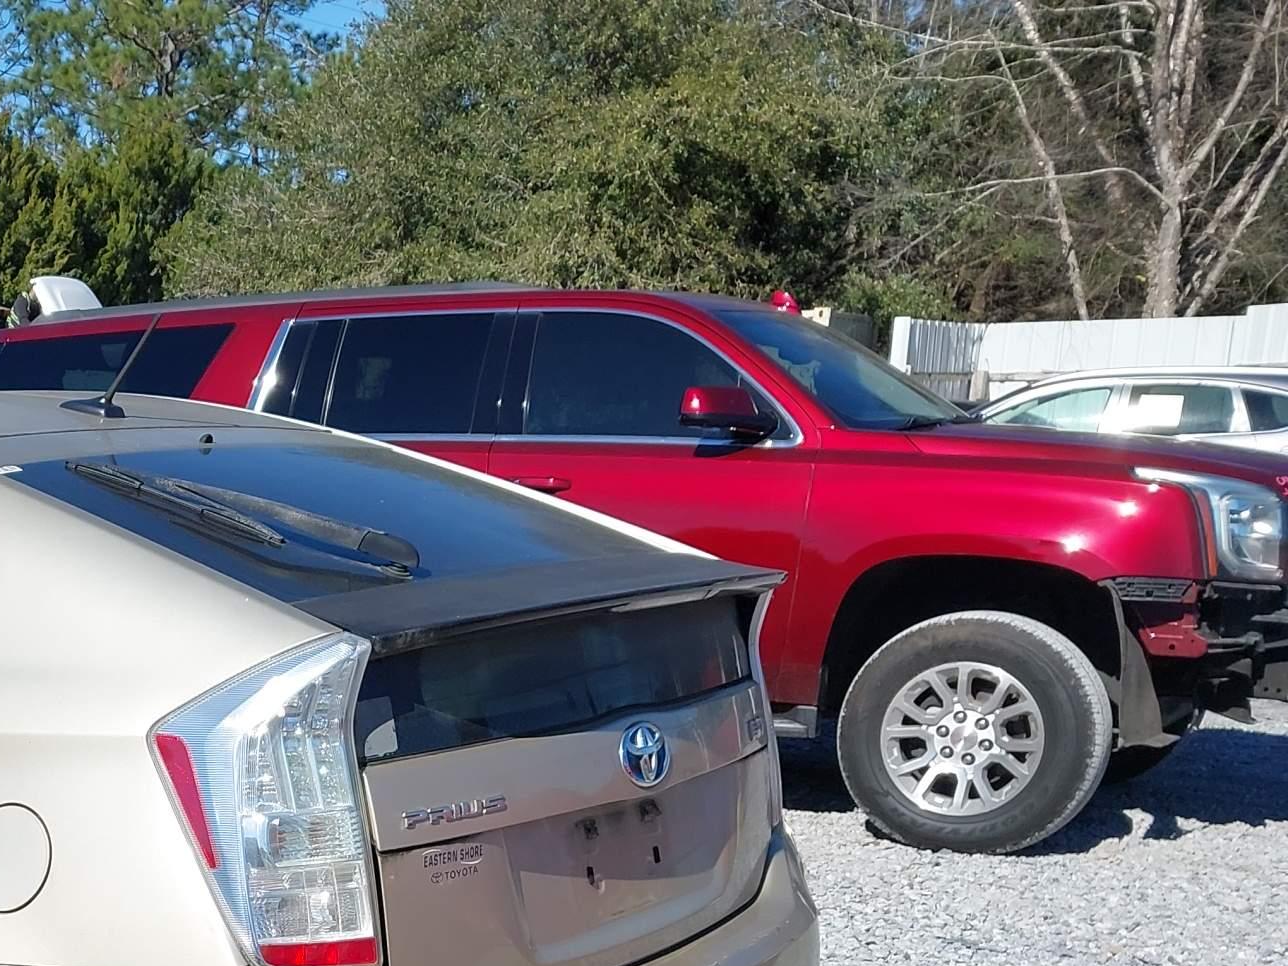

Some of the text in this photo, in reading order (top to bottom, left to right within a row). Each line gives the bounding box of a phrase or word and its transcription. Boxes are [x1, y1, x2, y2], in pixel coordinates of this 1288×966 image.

[402, 795, 507, 829] PRIUS
[423, 844, 483, 868] EASTERN SHORE
[445, 866, 479, 880] TOYOTA
